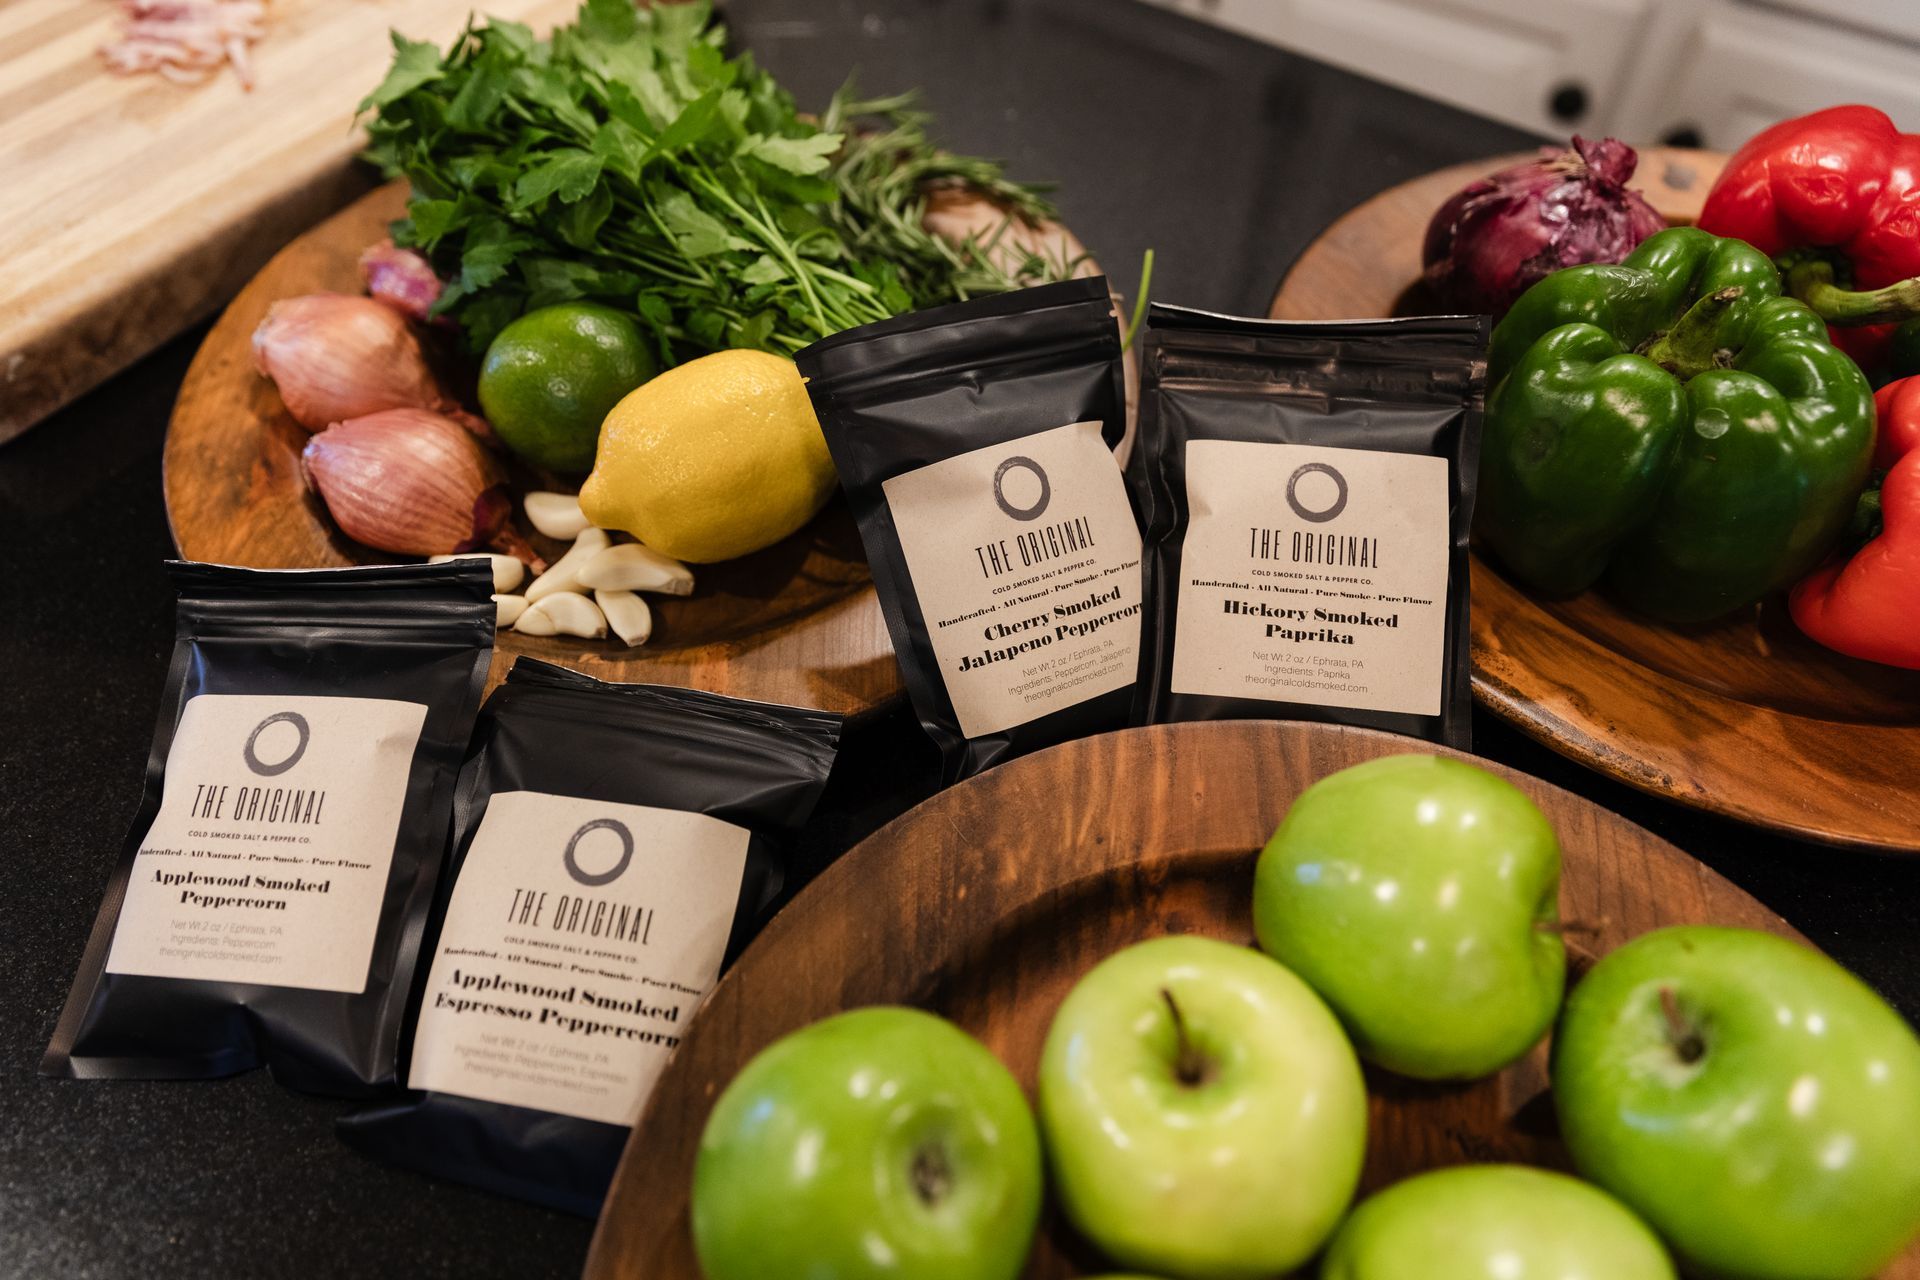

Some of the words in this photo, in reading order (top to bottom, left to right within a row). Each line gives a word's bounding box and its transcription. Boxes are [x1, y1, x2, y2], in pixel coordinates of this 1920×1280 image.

[975, 540, 1014, 579] THE
[1016, 516, 1095, 567] ORIGINAL
[1250, 528, 1281, 560] THE
[1292, 531, 1378, 568] ORIGINAL
[992, 584, 1011, 595] COLD
[1013, 576, 1040, 589] SMOKED
[1041, 570, 1056, 580] SALT
[1063, 562, 1085, 573] PEPPER
[1251, 569, 1271, 577] COLD
[1273, 571, 1303, 579] SMOKED
[938, 605, 996, 628] Handcrafted
[1003, 598, 1017, 609] All
[1018, 589, 1049, 605] Natural
[1054, 582, 1074, 592] Pure
[1074, 573, 1099, 585] Smoke
[1103, 566, 1121, 576] Pure
[1121, 560, 1139, 570] Flavor
[1192, 579, 1249, 590] Handcrafted
[1257, 584, 1271, 592] All
[1273, 585, 1309, 595] Natural
[1316, 589, 1338, 597] Pure
[1340, 591, 1371, 600] Smoke
[1378, 594, 1401, 602] Pure
[1403, 596, 1433, 605] Flavor
[984, 612, 1050, 641] Cherry
[1053, 585, 1121, 620] Smoked
[1224, 600, 1309, 622] Hickory
[1313, 607, 1398, 628] Smoked
[1265, 624, 1355, 645] Paprika
[958, 634, 1052, 672] Jalapeno
[1022, 667, 1037, 677] Net
[1038, 662, 1050, 672] Wt
[1051, 659, 1056, 668] 2
[1058, 657, 1066, 666] oz
[1103, 639, 1114, 648] PA
[1100, 646, 1131, 664] Jalapeno
[1252, 651, 1269, 661] Net
[1271, 653, 1283, 662] Wt
[1286, 654, 1291, 663] 2
[1294, 656, 1304, 664] oz
[1351, 660, 1364, 669] PA
[1024, 661, 1123, 703] theoriginalcoldsmoked.com
[1245, 674, 1368, 693] theoriginalcoldsmoked.com
[1317, 668, 1351, 680] Paprika
[191, 785, 228, 819] THE
[233, 786, 325, 825] ORIGINAL
[188, 830, 208, 838] COLD
[210, 832, 240, 840] SMOKED
[270, 835, 296, 843] PEPPER
[191, 850, 204, 858] All
[206, 851, 241, 860] Natural
[273, 855, 304, 864] Smoke
[312, 857, 335, 865] Pure
[338, 859, 371, 869] Flavor
[151, 869, 251, 888] Applewood
[253, 876, 330, 893] Smoked
[180, 890, 286, 910] Peppercorn
[170, 920, 186, 930] Net
[202, 921, 209, 931] 2
[269, 926, 283, 936] PA
[508, 888, 548, 927] THE
[553, 895, 653, 945] ORIGINAL
[222, 936, 276, 949] Peppercorn
[504, 936, 525, 944] COLD
[527, 940, 560, 950] SMOKED
[563, 945, 582, 955] SALT
[593, 949, 622, 961] PEPPER
[444, 947, 498, 959] Handcrafted
[507, 954, 521, 963] All
[524, 956, 562, 969] Natural
[570, 964, 595, 974] Pure
[598, 969, 633, 982] Smoke
[642, 976, 667, 988] Pure
[447, 968, 576, 1003] Applewood
[580, 989, 679, 1022] Smoked
[434, 992, 532, 1020] Espresso
[539, 1008, 681, 1049] Peppercorn
